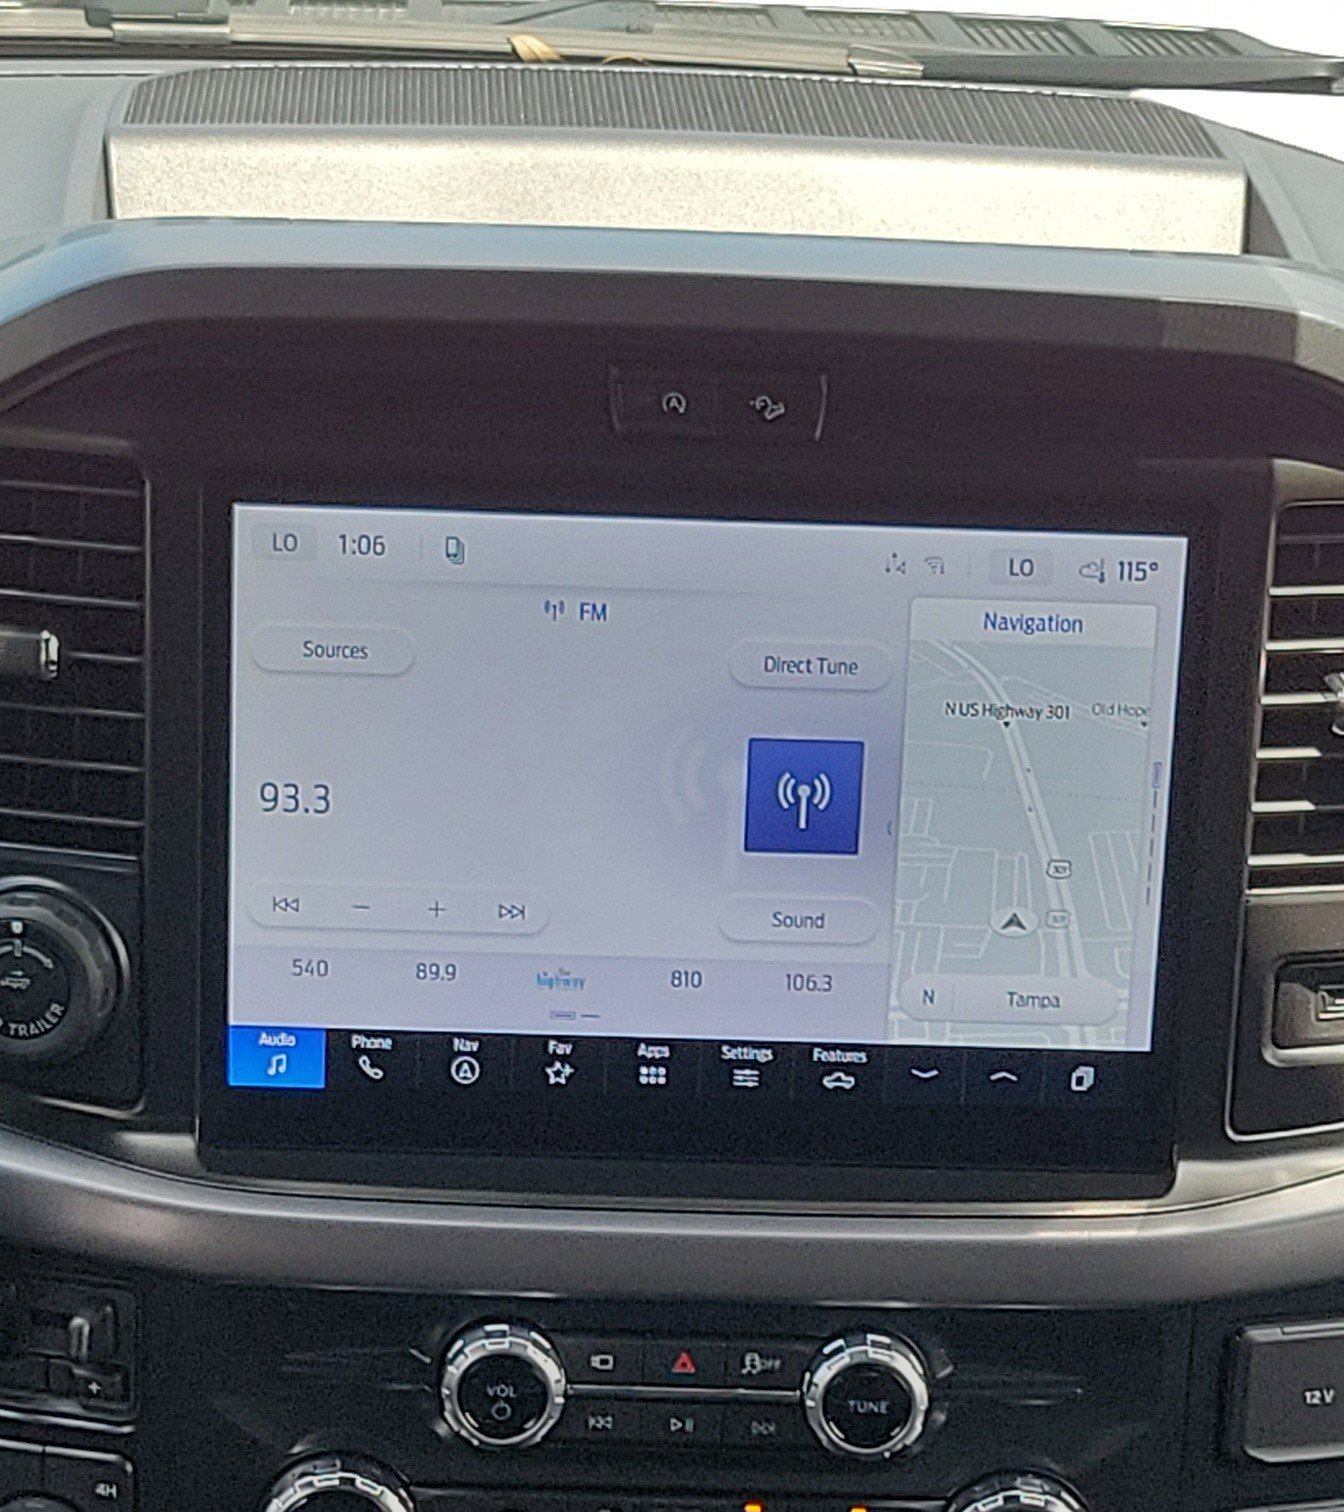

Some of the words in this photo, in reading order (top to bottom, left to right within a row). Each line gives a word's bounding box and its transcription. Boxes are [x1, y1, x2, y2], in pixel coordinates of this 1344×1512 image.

[272, 532, 298, 552] LO
[338, 533, 387, 556] 1:06
[1008, 559, 1034, 578] LO
[579, 602, 608, 622] FM
[982, 612, 1084, 637] Navigation
[302, 640, 369, 660] Sources
[763, 655, 813, 676] Direct
[816, 657, 860, 676] Tune
[944, 700, 956, 717] N
[958, 701, 980, 718] US
[981, 701, 1044, 723] Highway
[1046, 703, 1071, 720] 301
[1091, 701, 1114, 717] Old
[258, 782, 332, 815] 93.3
[771, 910, 826, 930] Sound
[291, 959, 330, 977] 540
[415, 962, 458, 982] 89.9
[670, 970, 703, 989] 810
[785, 973, 834, 993] 106.3
[922, 989, 936, 1006] N
[1006, 991, 1063, 1010] Tampa
[8, 1003, 65, 1037] TRAILER
[258, 1032, 297, 1047] Audio
[351, 1035, 393, 1050] Phone
[453, 1038, 479, 1052] Nav
[547, 1040, 573, 1055] Fav
[637, 1043, 671, 1060] Apps
[720, 1045, 775, 1063] Settings
[812, 1047, 869, 1065] Features
[487, 1384, 517, 1398] VOL
[1304, 1391, 1322, 1404] 12
[1323, 1390, 1336, 1403] V
[849, 1400, 888, 1414] TUNE
[95, 1483, 118, 1498] 4H
